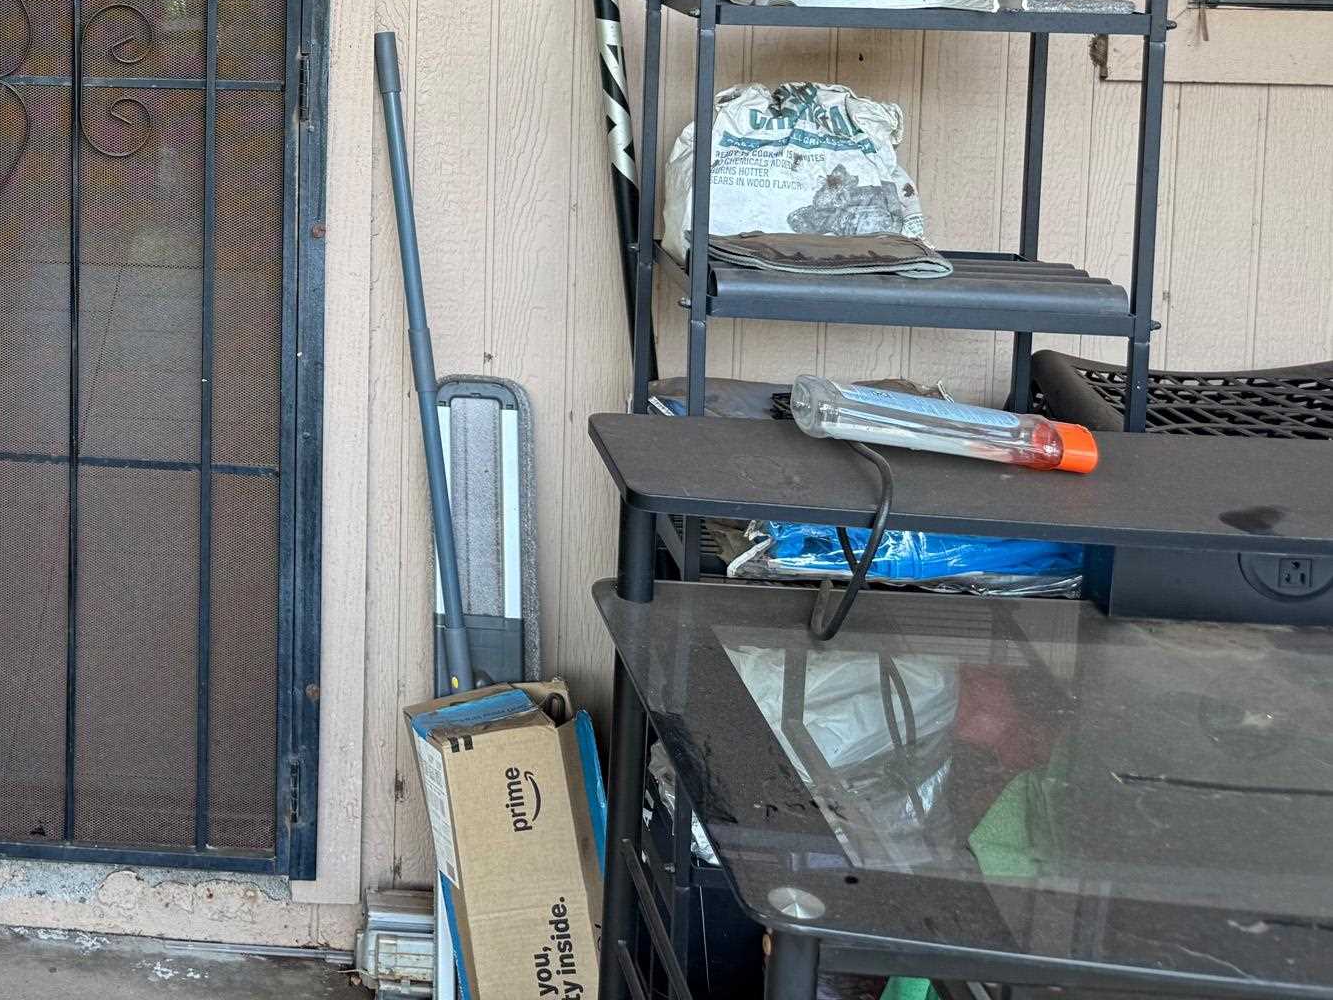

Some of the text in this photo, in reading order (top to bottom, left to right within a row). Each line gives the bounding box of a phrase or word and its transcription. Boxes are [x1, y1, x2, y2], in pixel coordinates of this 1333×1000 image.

[736, 176, 745, 187] IN
[747, 178, 771, 188] WOOD
[738, 167, 769, 177] HOTTER
[505, 767, 533, 832] prime
[549, 896, 577, 974] inside.
[534, 946, 559, 997] you,
